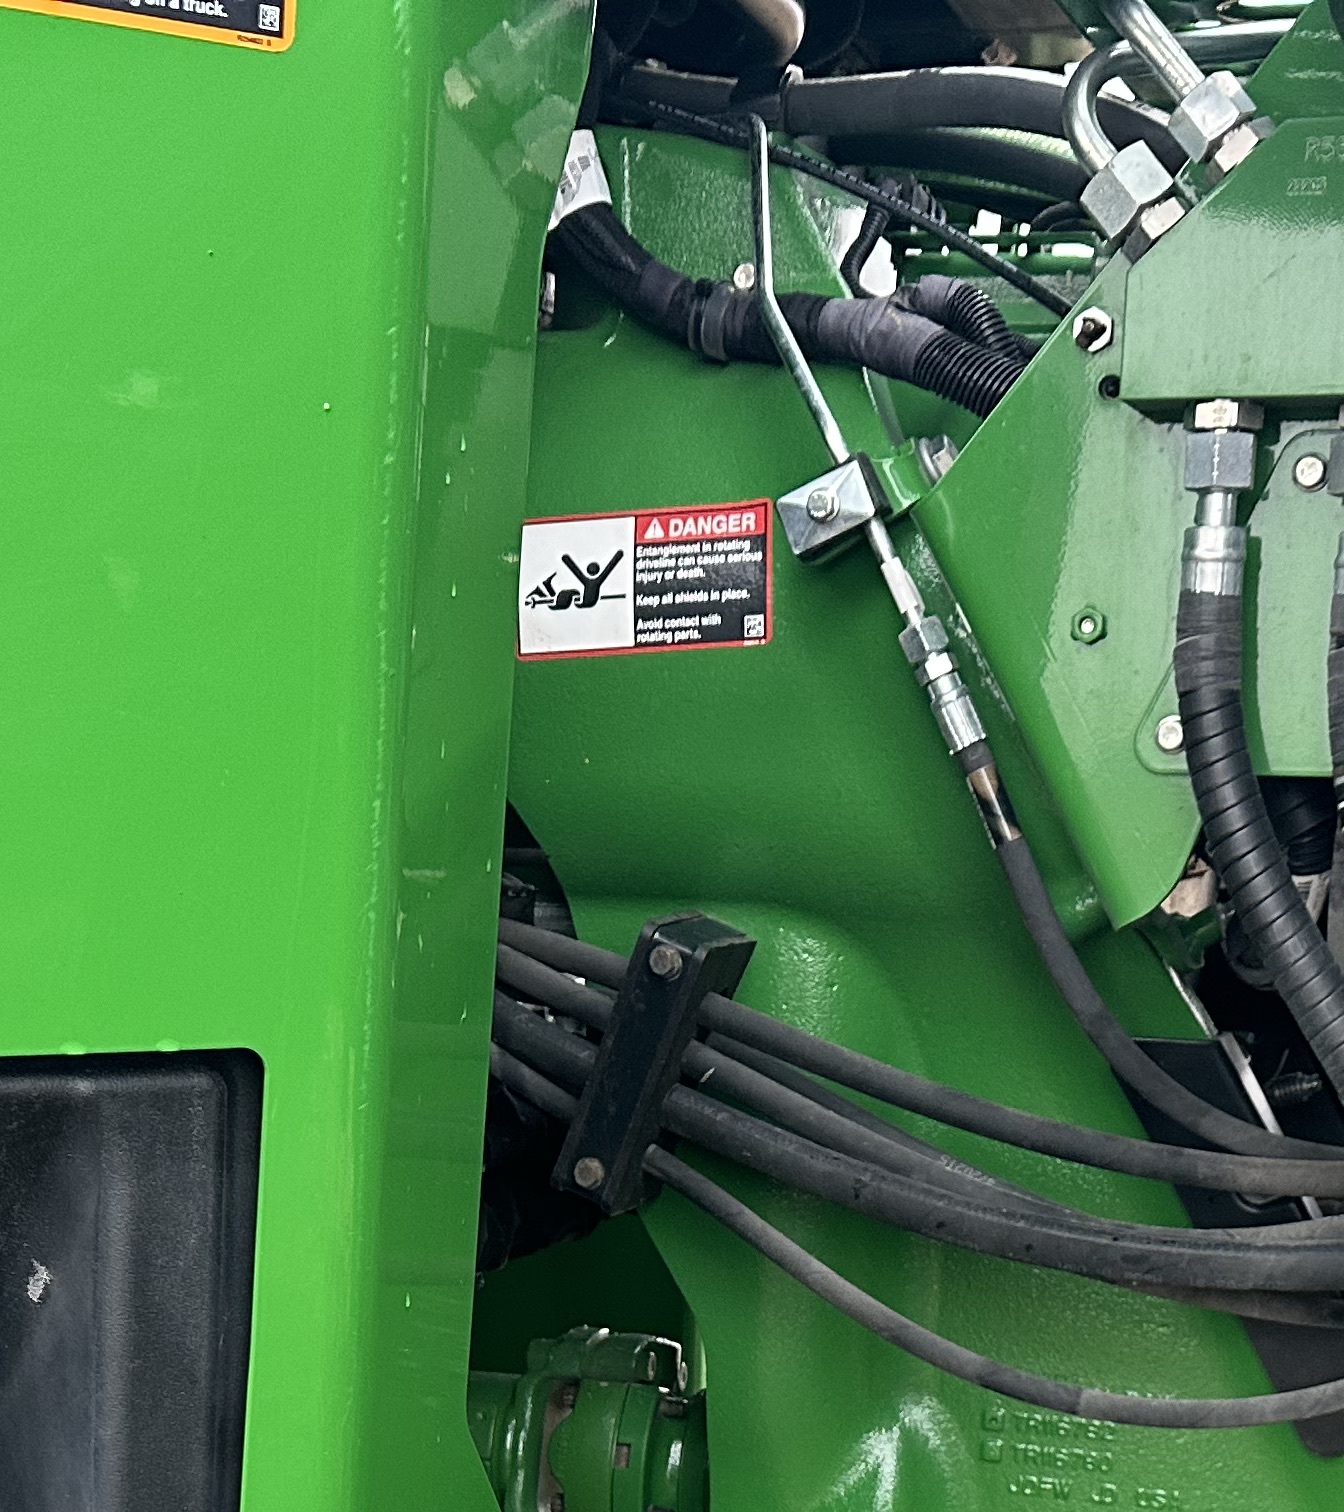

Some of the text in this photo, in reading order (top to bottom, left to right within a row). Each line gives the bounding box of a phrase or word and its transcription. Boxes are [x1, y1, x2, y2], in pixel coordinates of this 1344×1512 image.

[183, 0, 229, 18] truck.
[668, 511, 756, 538] DANGER
[636, 538, 751, 558] Entanglement in rotating
[636, 550, 763, 570] driveline can cause serious
[636, 565, 705, 584] injury or death.
[636, 587, 751, 607] Keep all shields in place.
[636, 612, 722, 630] Avoid contact with
[636, 627, 702, 643] rotating parts.
